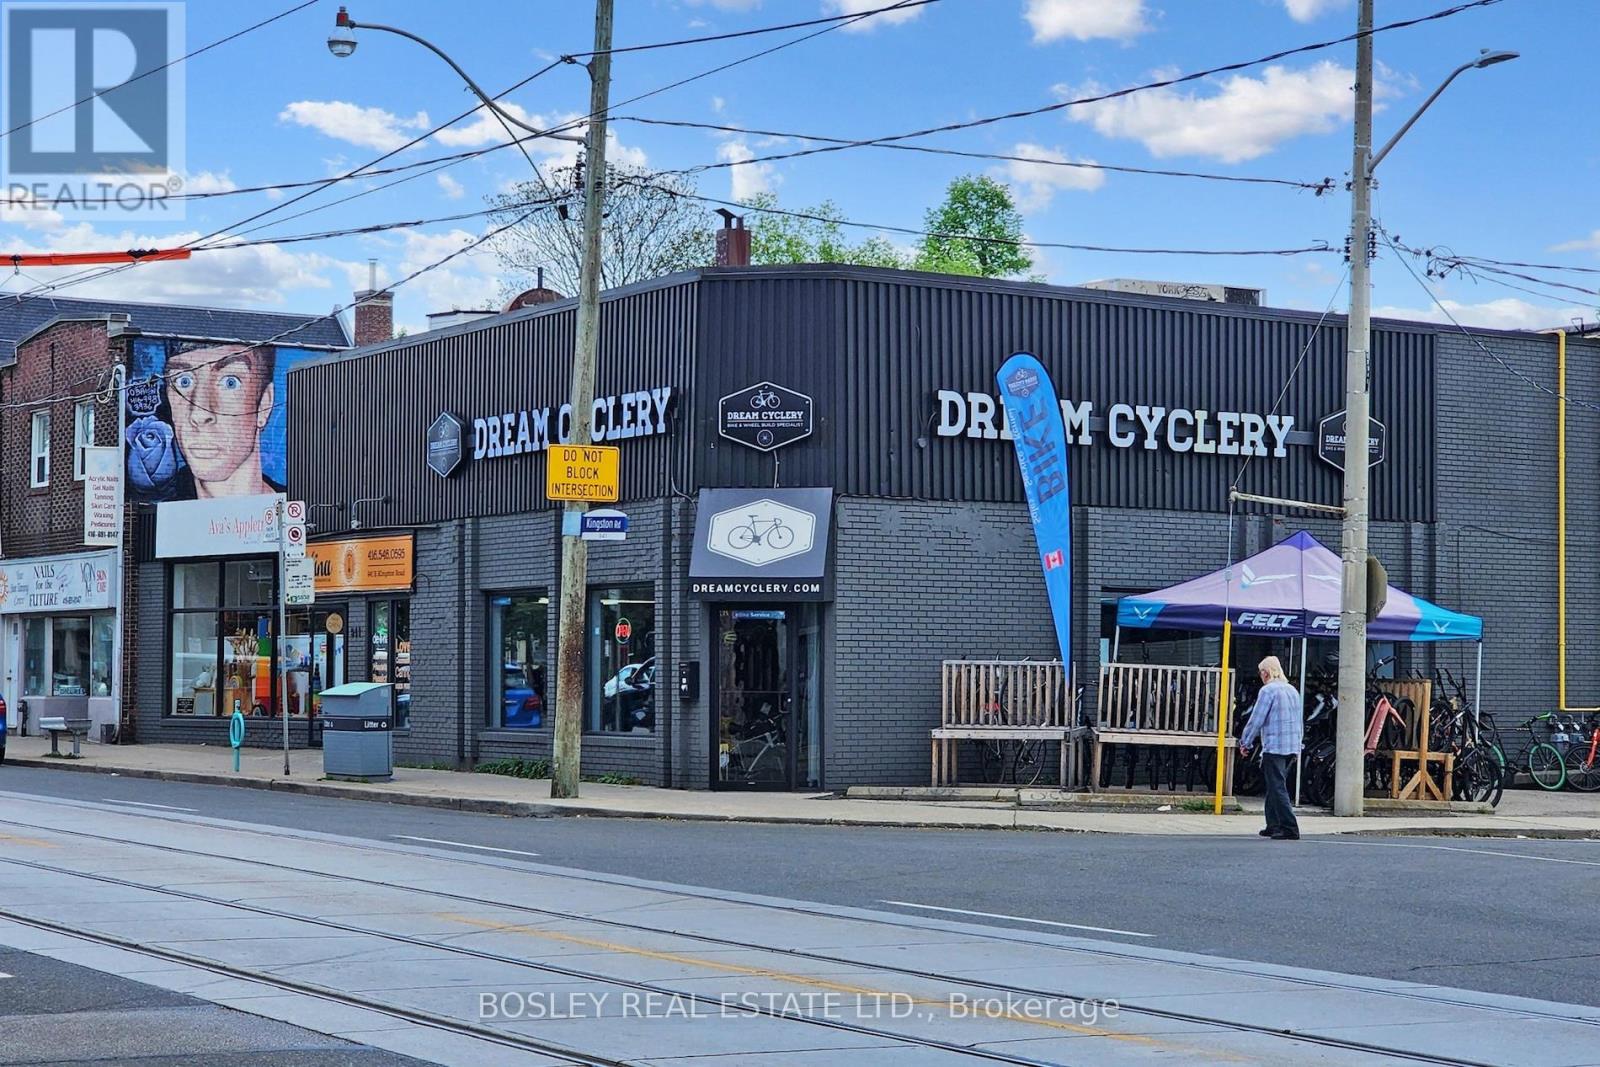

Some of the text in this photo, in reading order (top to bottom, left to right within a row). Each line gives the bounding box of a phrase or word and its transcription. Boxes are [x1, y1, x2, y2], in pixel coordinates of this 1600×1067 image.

[727, 410, 804, 420] DREAM CYCLERY
[473, 386, 671, 460] DREAM CCLERY
[1108, 403, 1295, 458] CYCLERY
[563, 449, 603, 463] DO NOT
[566, 465, 599, 479] BLOCK
[551, 482, 614, 497] INTERSECTION
[94, 493, 114, 501] Tanning
[209, 516, 231, 535] Ava's
[586, 517, 614, 532] Kingston
[33, 564, 55, 578] NAILS
[35, 579, 43, 590] for
[44, 579, 53, 589] the
[692, 583, 820, 593] DREAMCYCLERY.COM
[29, 593, 59, 607] FUTURE
[1237, 612, 1298, 628] FELT
[364, 720, 379, 729] Litter
